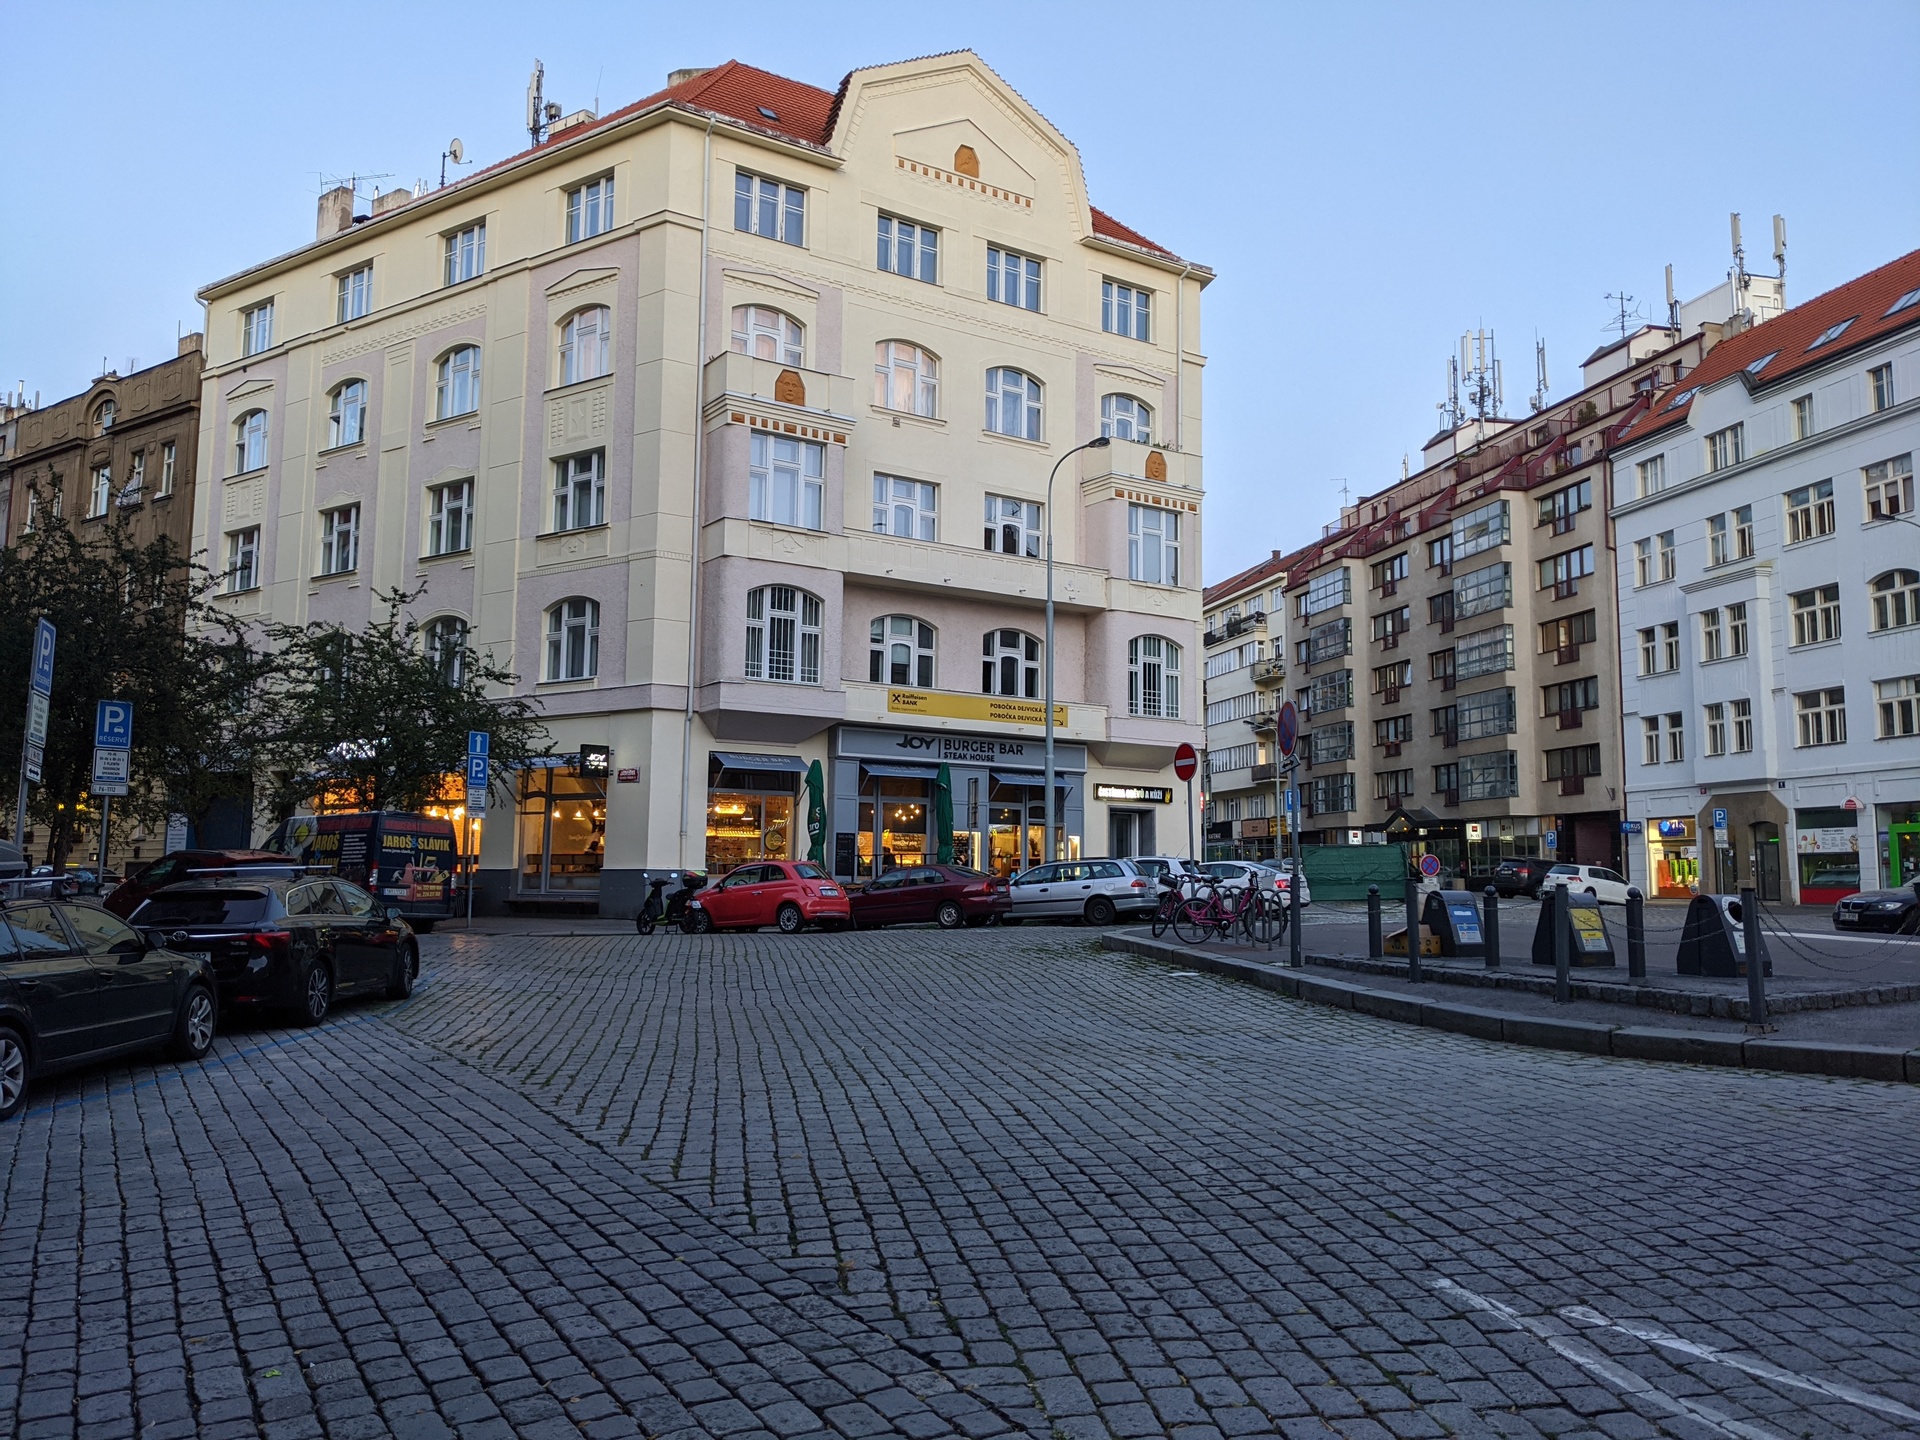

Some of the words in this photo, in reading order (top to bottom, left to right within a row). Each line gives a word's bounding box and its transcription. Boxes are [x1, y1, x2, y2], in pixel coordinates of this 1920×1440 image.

[39, 629, 51, 669] P
[902, 693, 928, 701] Raiffeisen
[990, 702, 1017, 711] POBOČKA
[1017, 704, 1043, 714] DEJVICKÁ
[104, 706, 125, 733] P
[990, 712, 1017, 721] POBOČKA
[1017, 714, 1043, 723] DEJVICKÁ
[99, 735, 127, 744] RÉSERVÉ
[896, 734, 936, 750] JOY
[944, 739, 995, 753] BURGER
[999, 743, 1024, 756] BAR
[944, 752, 968, 760] STEAK
[970, 753, 995, 762] HOUSE
[472, 759, 484, 777] P
[1145, 790, 1150, 799] A
[1716, 810, 1724, 823] P
[382, 834, 412, 849] JAROŠ
[418, 836, 450, 852] SLÁVIK
[1547, 832, 1555, 843] P
